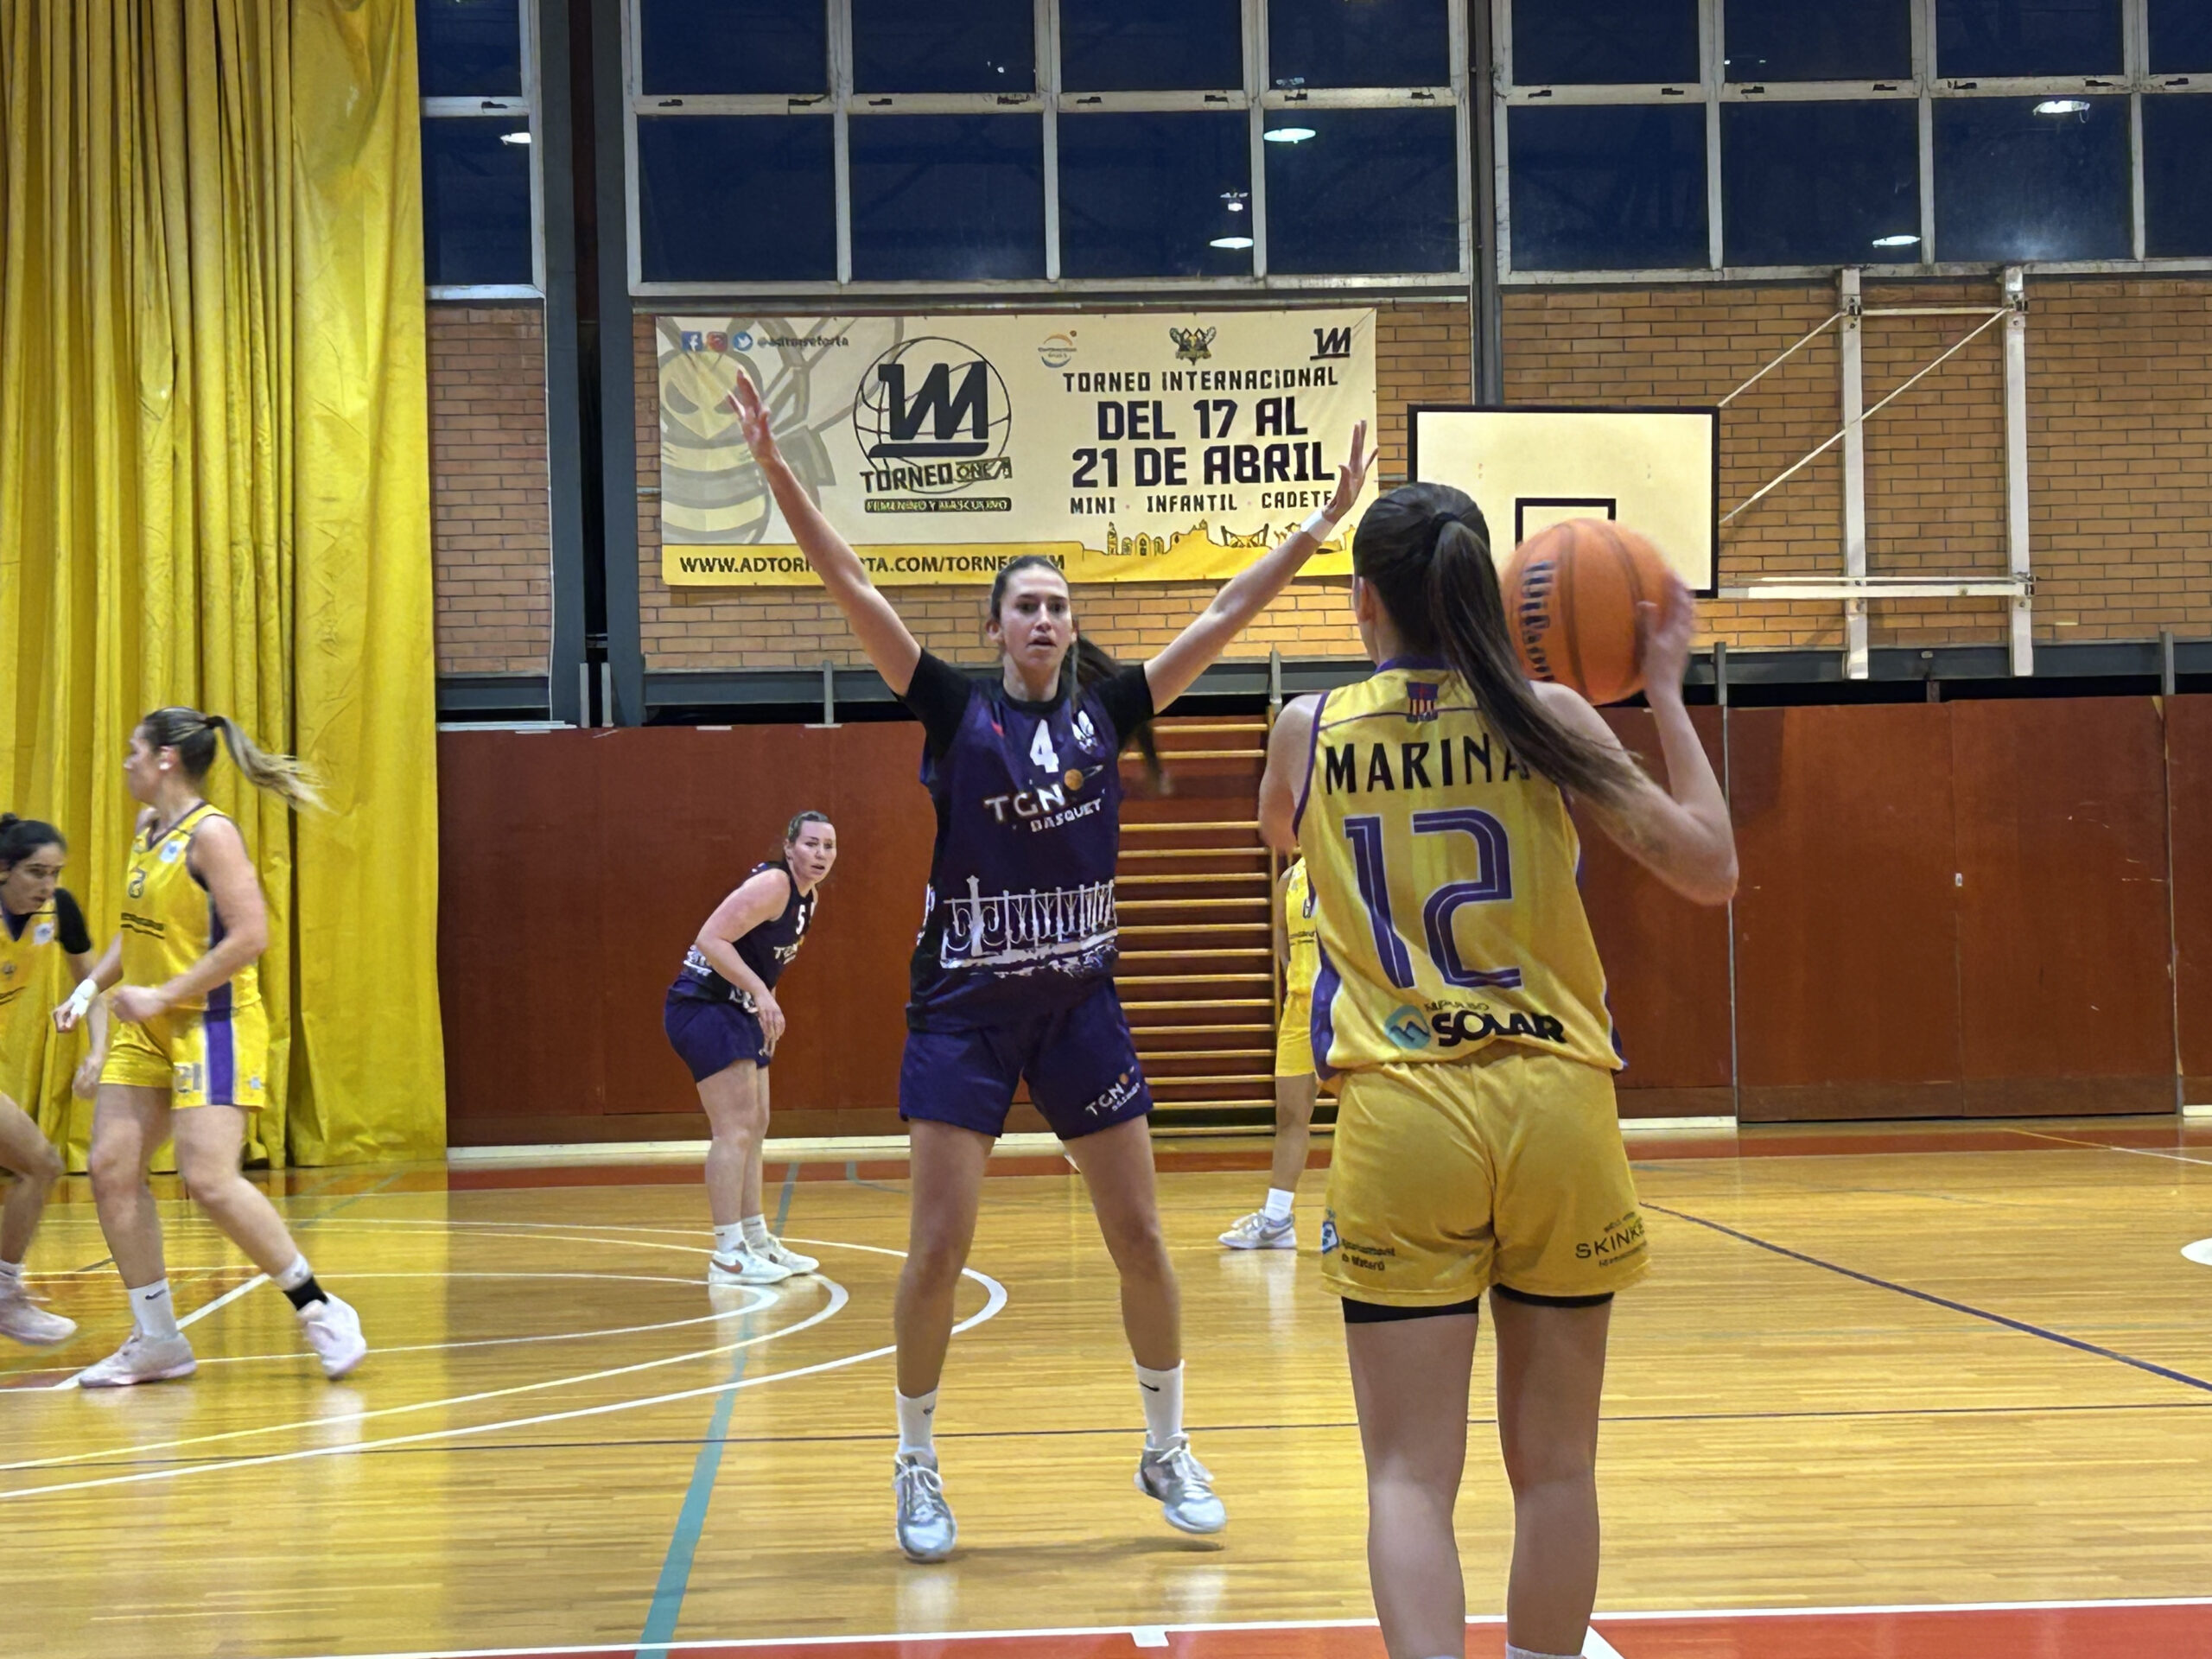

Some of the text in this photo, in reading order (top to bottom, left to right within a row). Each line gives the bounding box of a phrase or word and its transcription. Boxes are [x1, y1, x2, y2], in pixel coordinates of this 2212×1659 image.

[1063, 366, 1338, 392] TORNEO INTERNACIONAL
[1097, 396, 1308, 440] DEL 17 AL
[860, 463, 953, 493] TORNEO
[1072, 442, 1335, 487] 21 DE ABRIL
[1070, 496, 1116, 514] MINI
[1147, 493, 1237, 512] INFANTIL
[1030, 719, 1059, 773] 4
[984, 784, 1065, 822] TGN
[1344, 808, 1522, 990] 12
[1431, 1009, 1567, 1047] SOLAR
[1085, 1082, 1125, 1116] TGN
